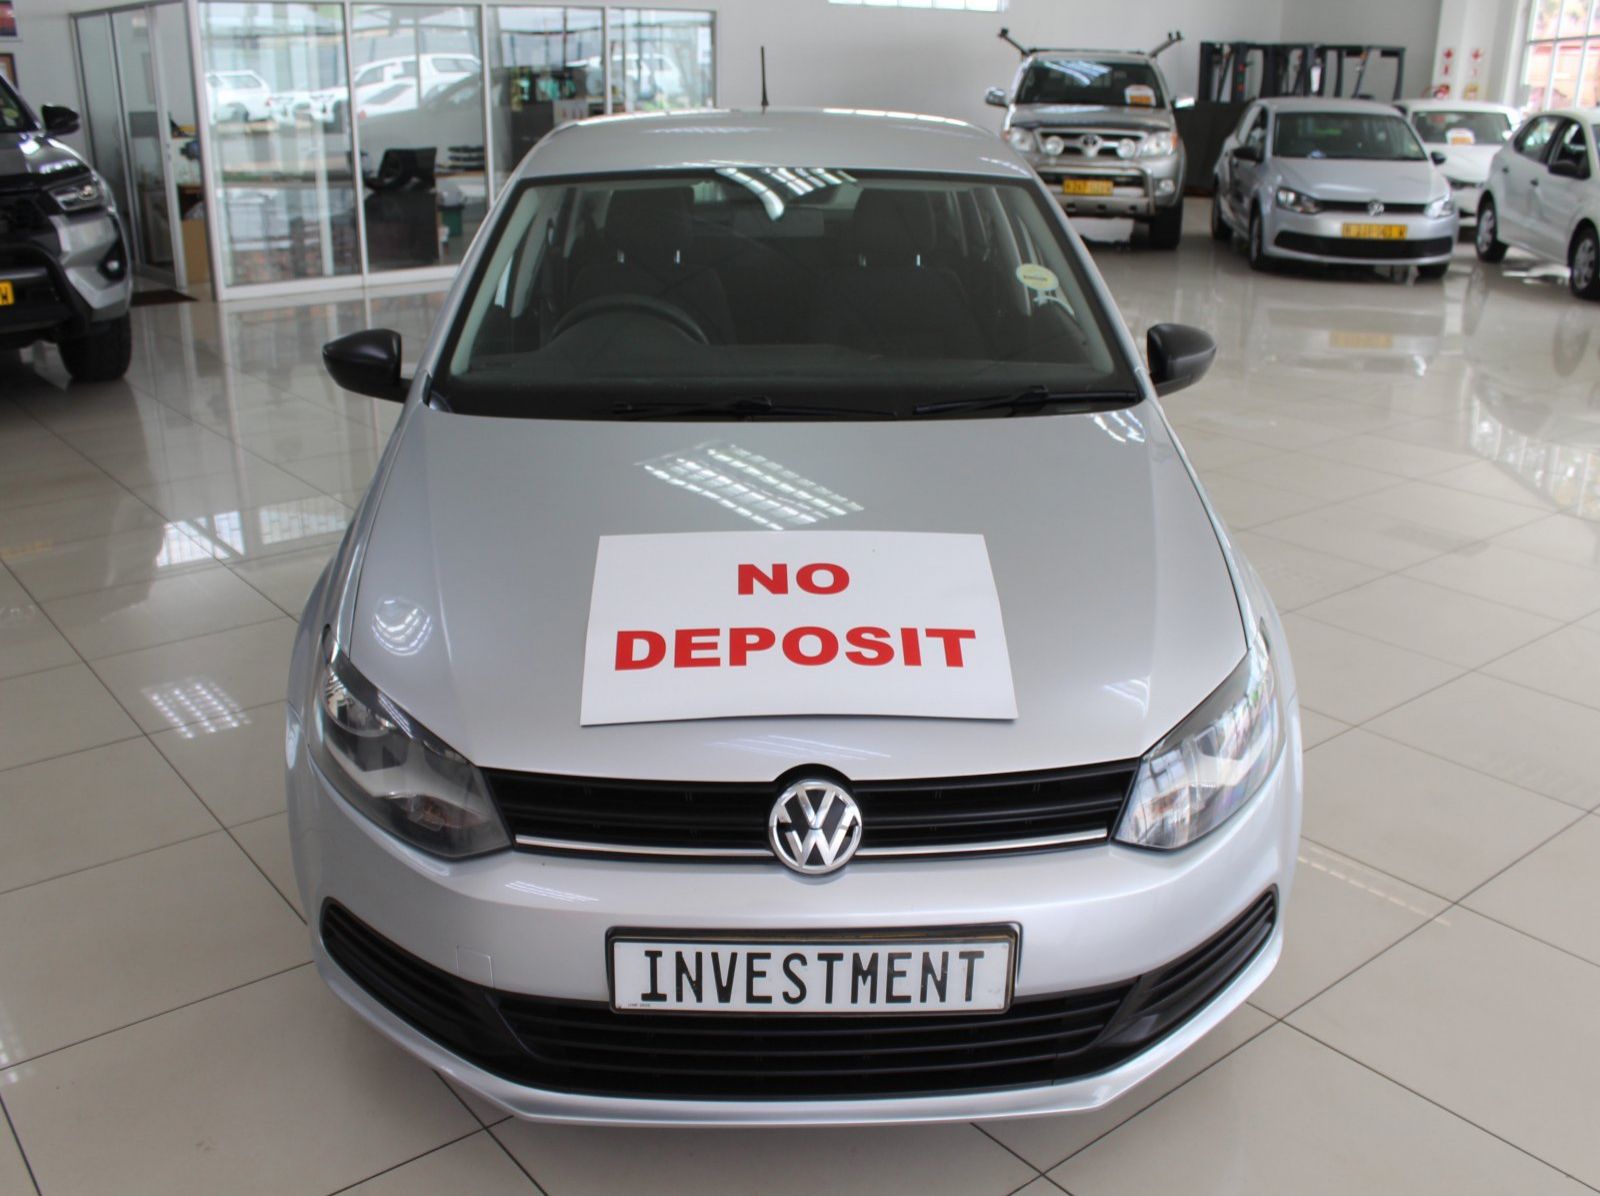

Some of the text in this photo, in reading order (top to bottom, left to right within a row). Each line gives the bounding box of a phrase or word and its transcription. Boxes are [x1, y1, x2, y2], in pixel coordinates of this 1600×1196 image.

[737, 562, 850, 596] NO
[614, 626, 976, 672] DEPOSIT
[640, 949, 985, 1006] INVESTMENT
